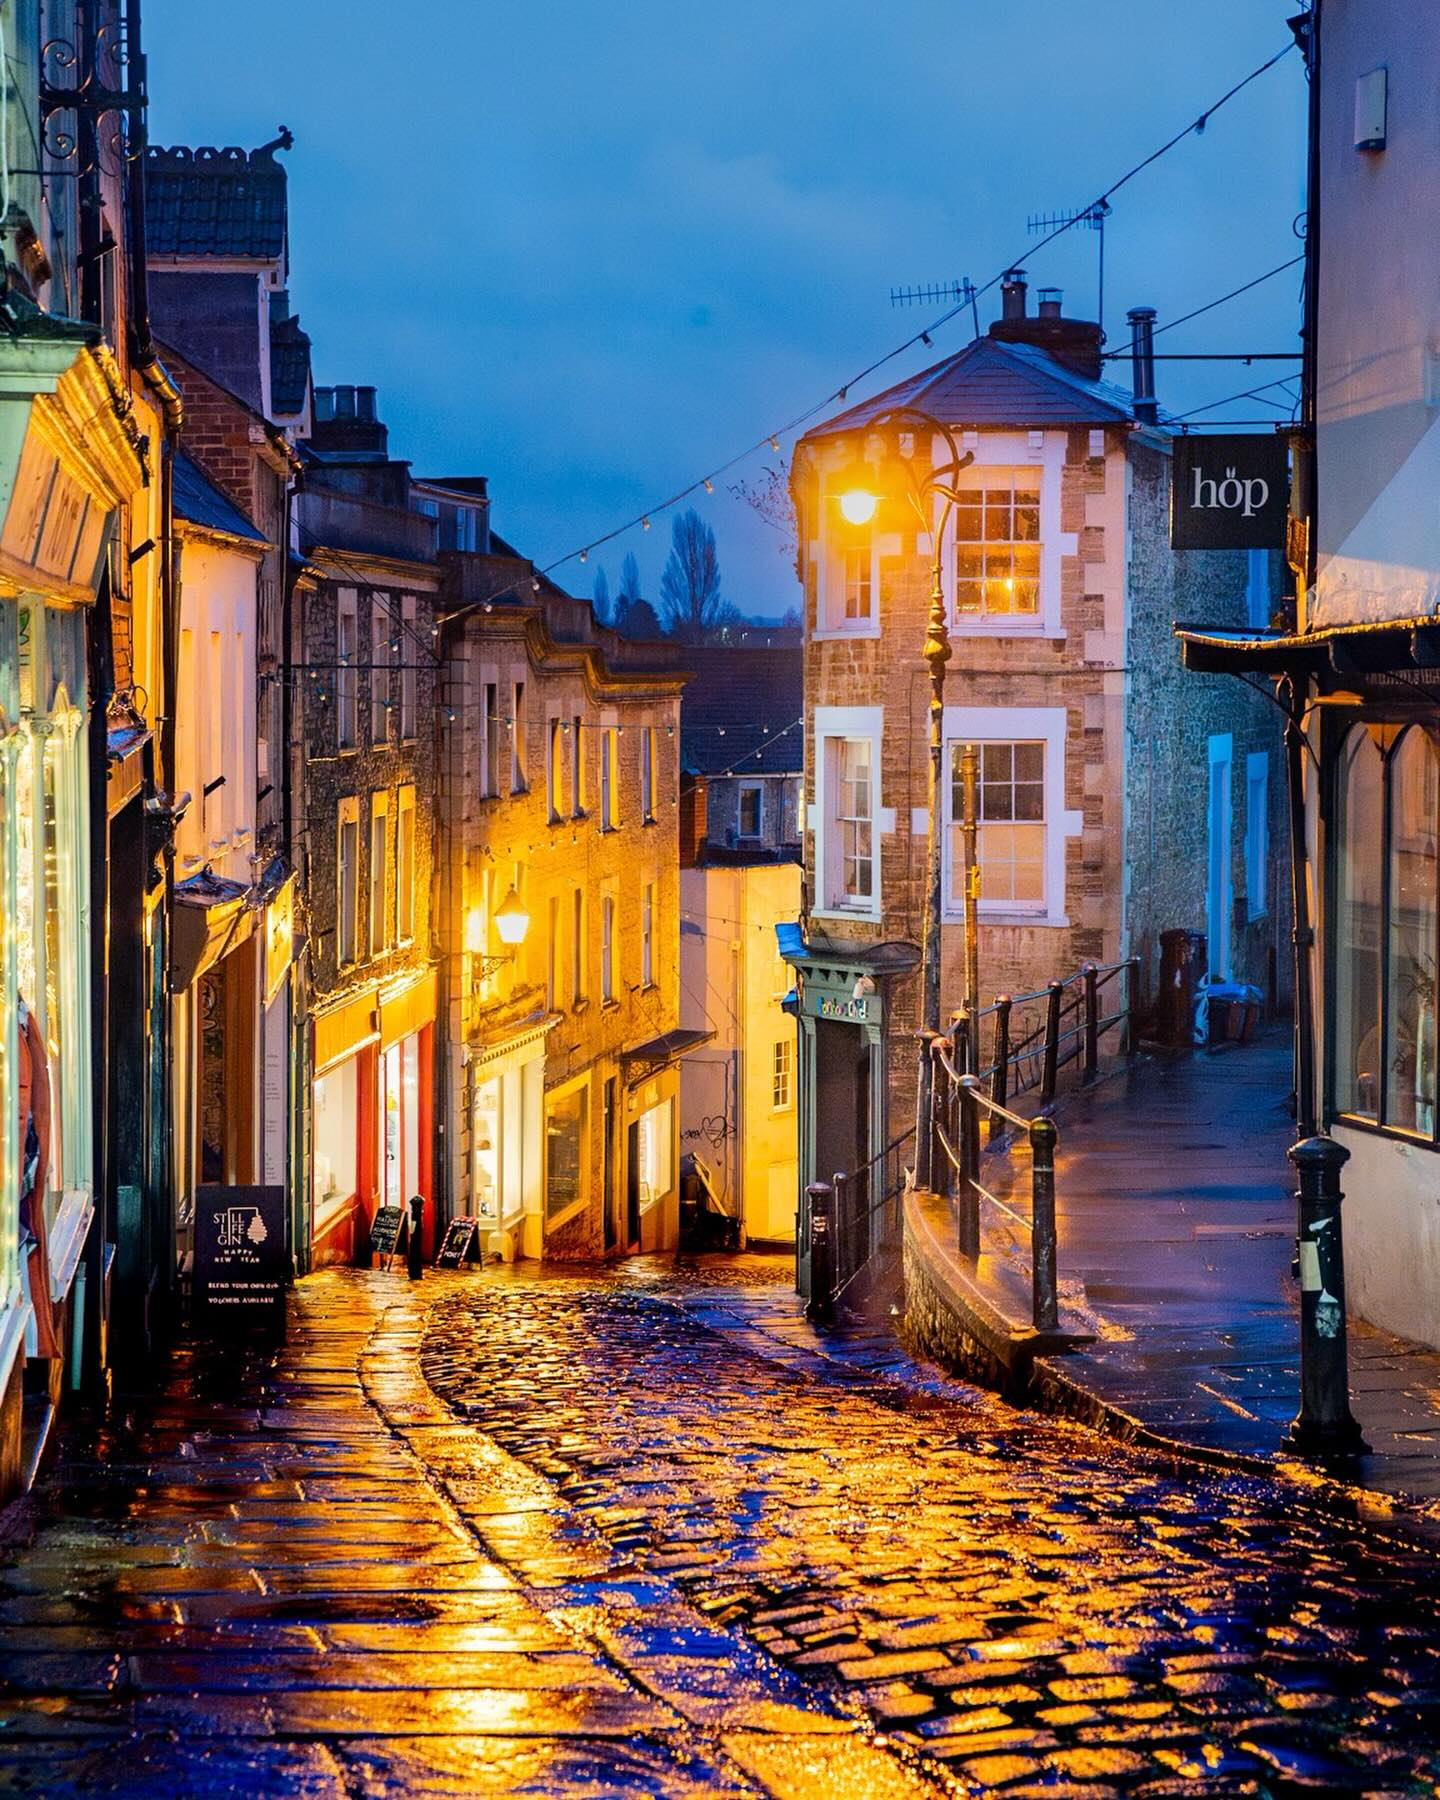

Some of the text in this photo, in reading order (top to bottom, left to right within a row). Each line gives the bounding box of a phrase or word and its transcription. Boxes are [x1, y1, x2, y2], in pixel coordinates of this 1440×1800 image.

[213, 1213, 245, 1224] STILL
[220, 1224, 245, 1234] LIFE
[217, 1235, 242, 1246] GIN
